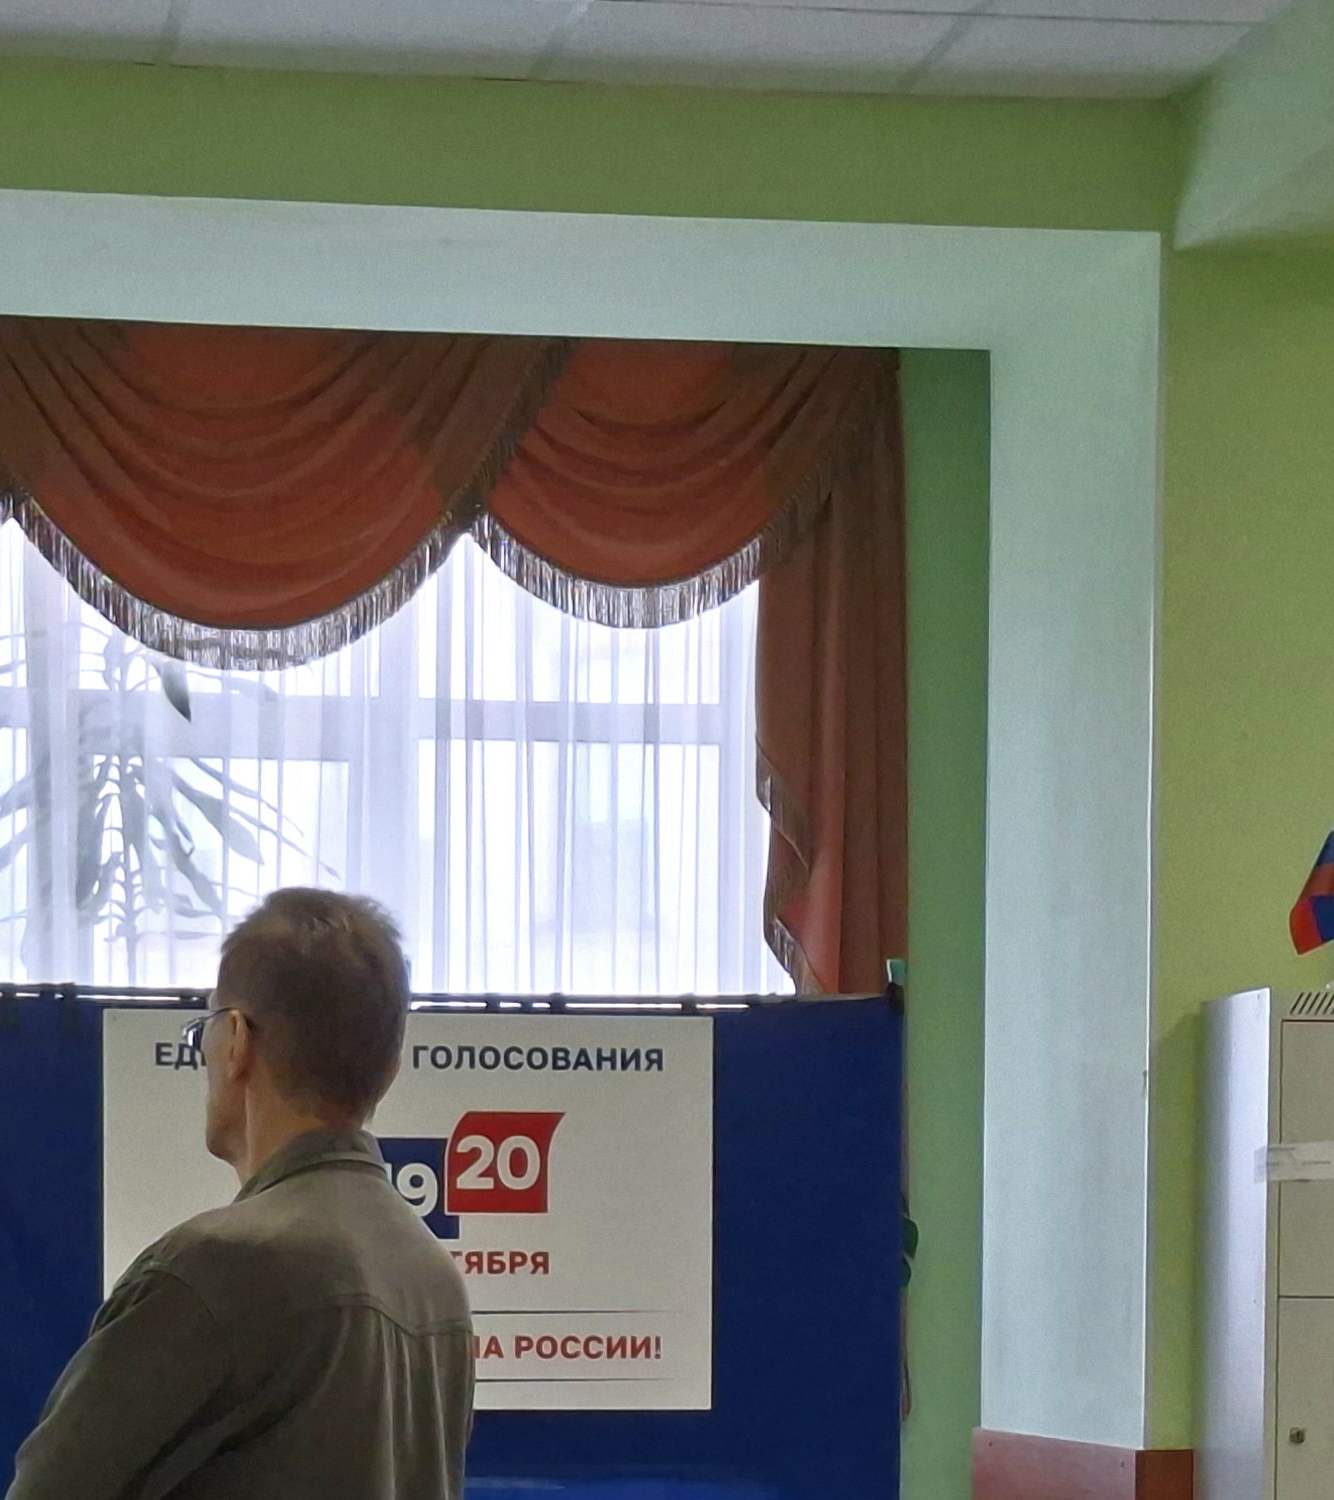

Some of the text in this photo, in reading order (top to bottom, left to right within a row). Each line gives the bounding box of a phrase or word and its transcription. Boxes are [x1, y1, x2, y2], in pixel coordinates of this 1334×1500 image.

[412, 1045, 664, 1072] ГОЛОСОВАНИЯ
[455, 1134, 541, 1191] 20
[515, 1335, 661, 1360] РОССИИ!
